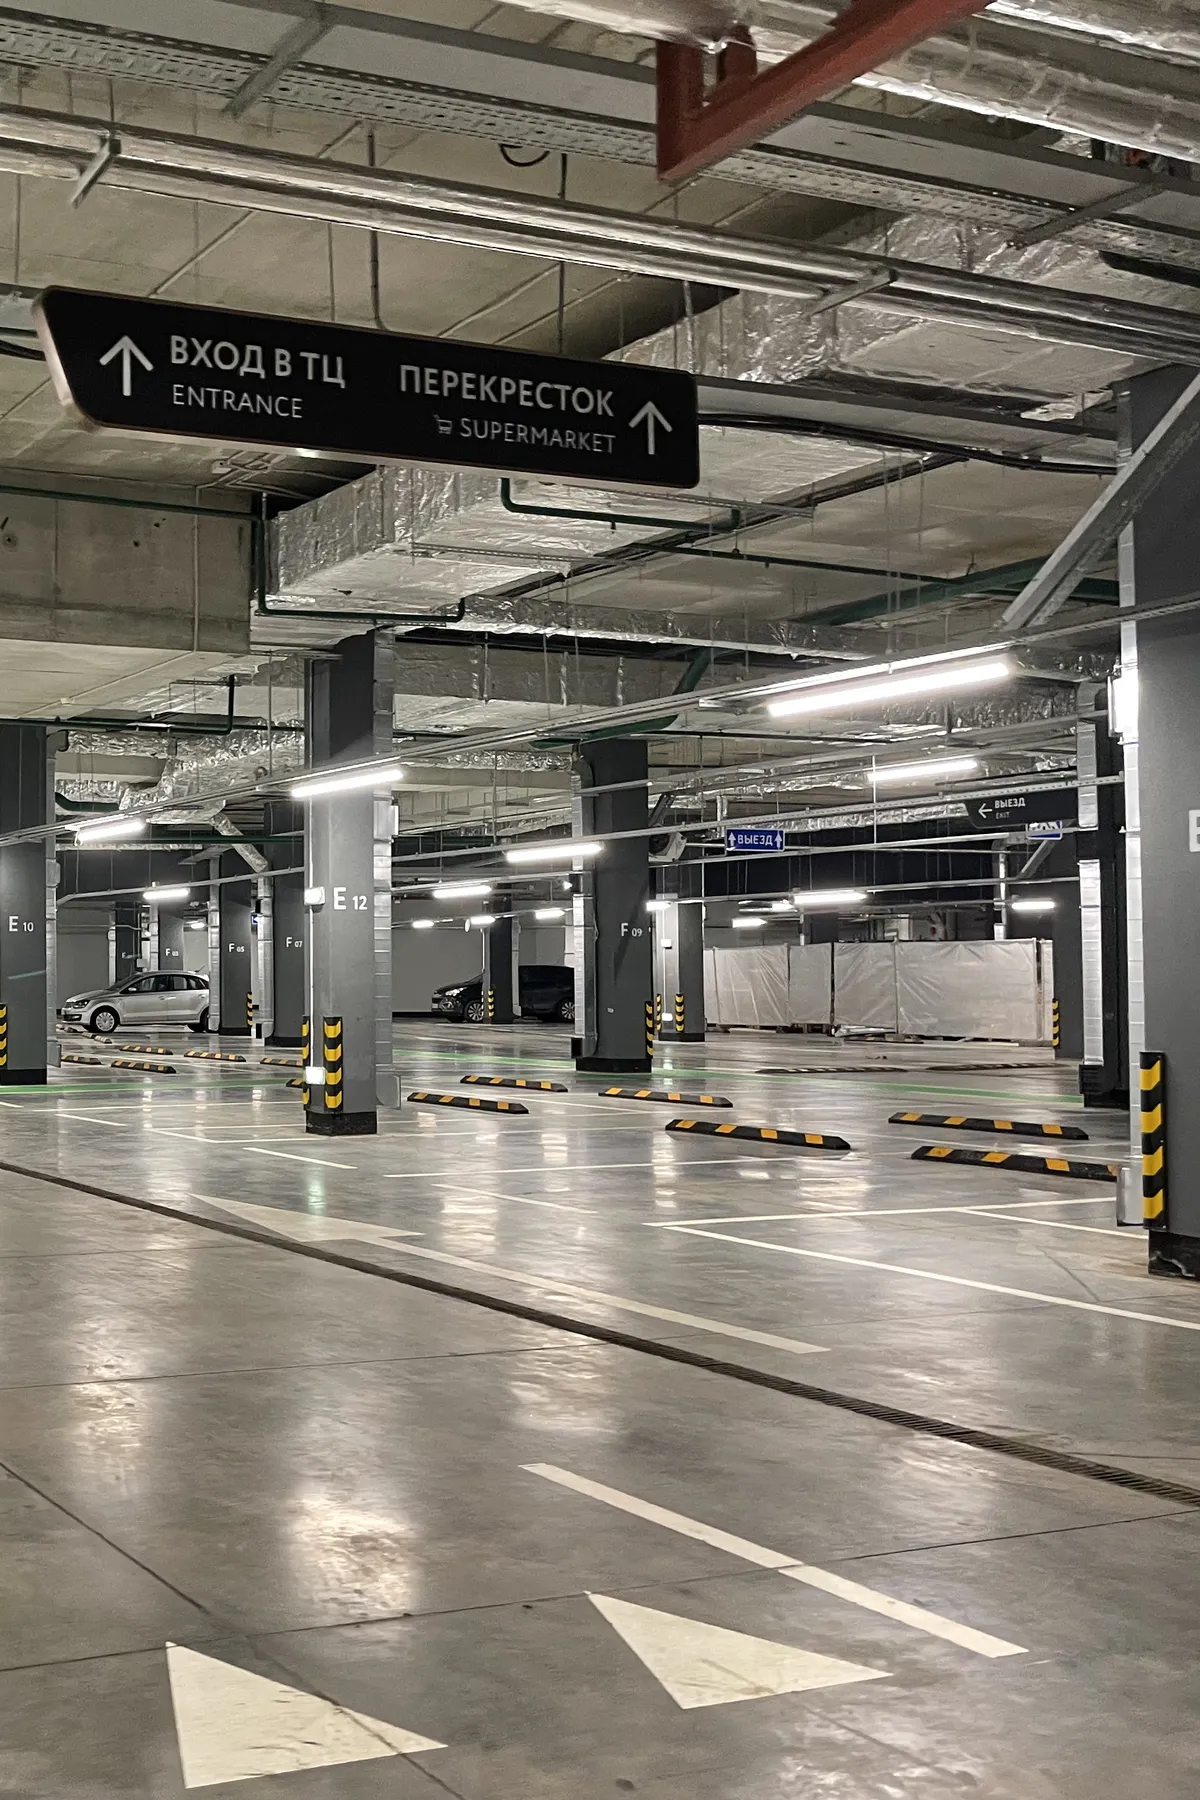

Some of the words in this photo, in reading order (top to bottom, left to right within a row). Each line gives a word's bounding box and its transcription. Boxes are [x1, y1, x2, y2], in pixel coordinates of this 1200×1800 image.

[170, 334, 266, 379] ВХОД
[274, 348, 293, 377] В
[300, 351, 346, 388] ТЦ
[400, 364, 615, 417] ПЕРЕКРЕСТОК
[172, 384, 303, 418] ENTRANCE
[460, 418, 616, 453] SUPERMARKET
[994, 797, 1026, 809] ВЫЕЗД
[737, 834, 773, 847] ВЫЕЗД
[333, 887, 347, 910] E
[352, 895, 368, 910] 12
[9, 915, 19, 932] E
[23, 922, 34, 932] 10
[621, 922, 629, 937] F
[631, 928, 643, 937] 09
[228, 943, 235, 953] F
[286, 937, 293, 948] F
